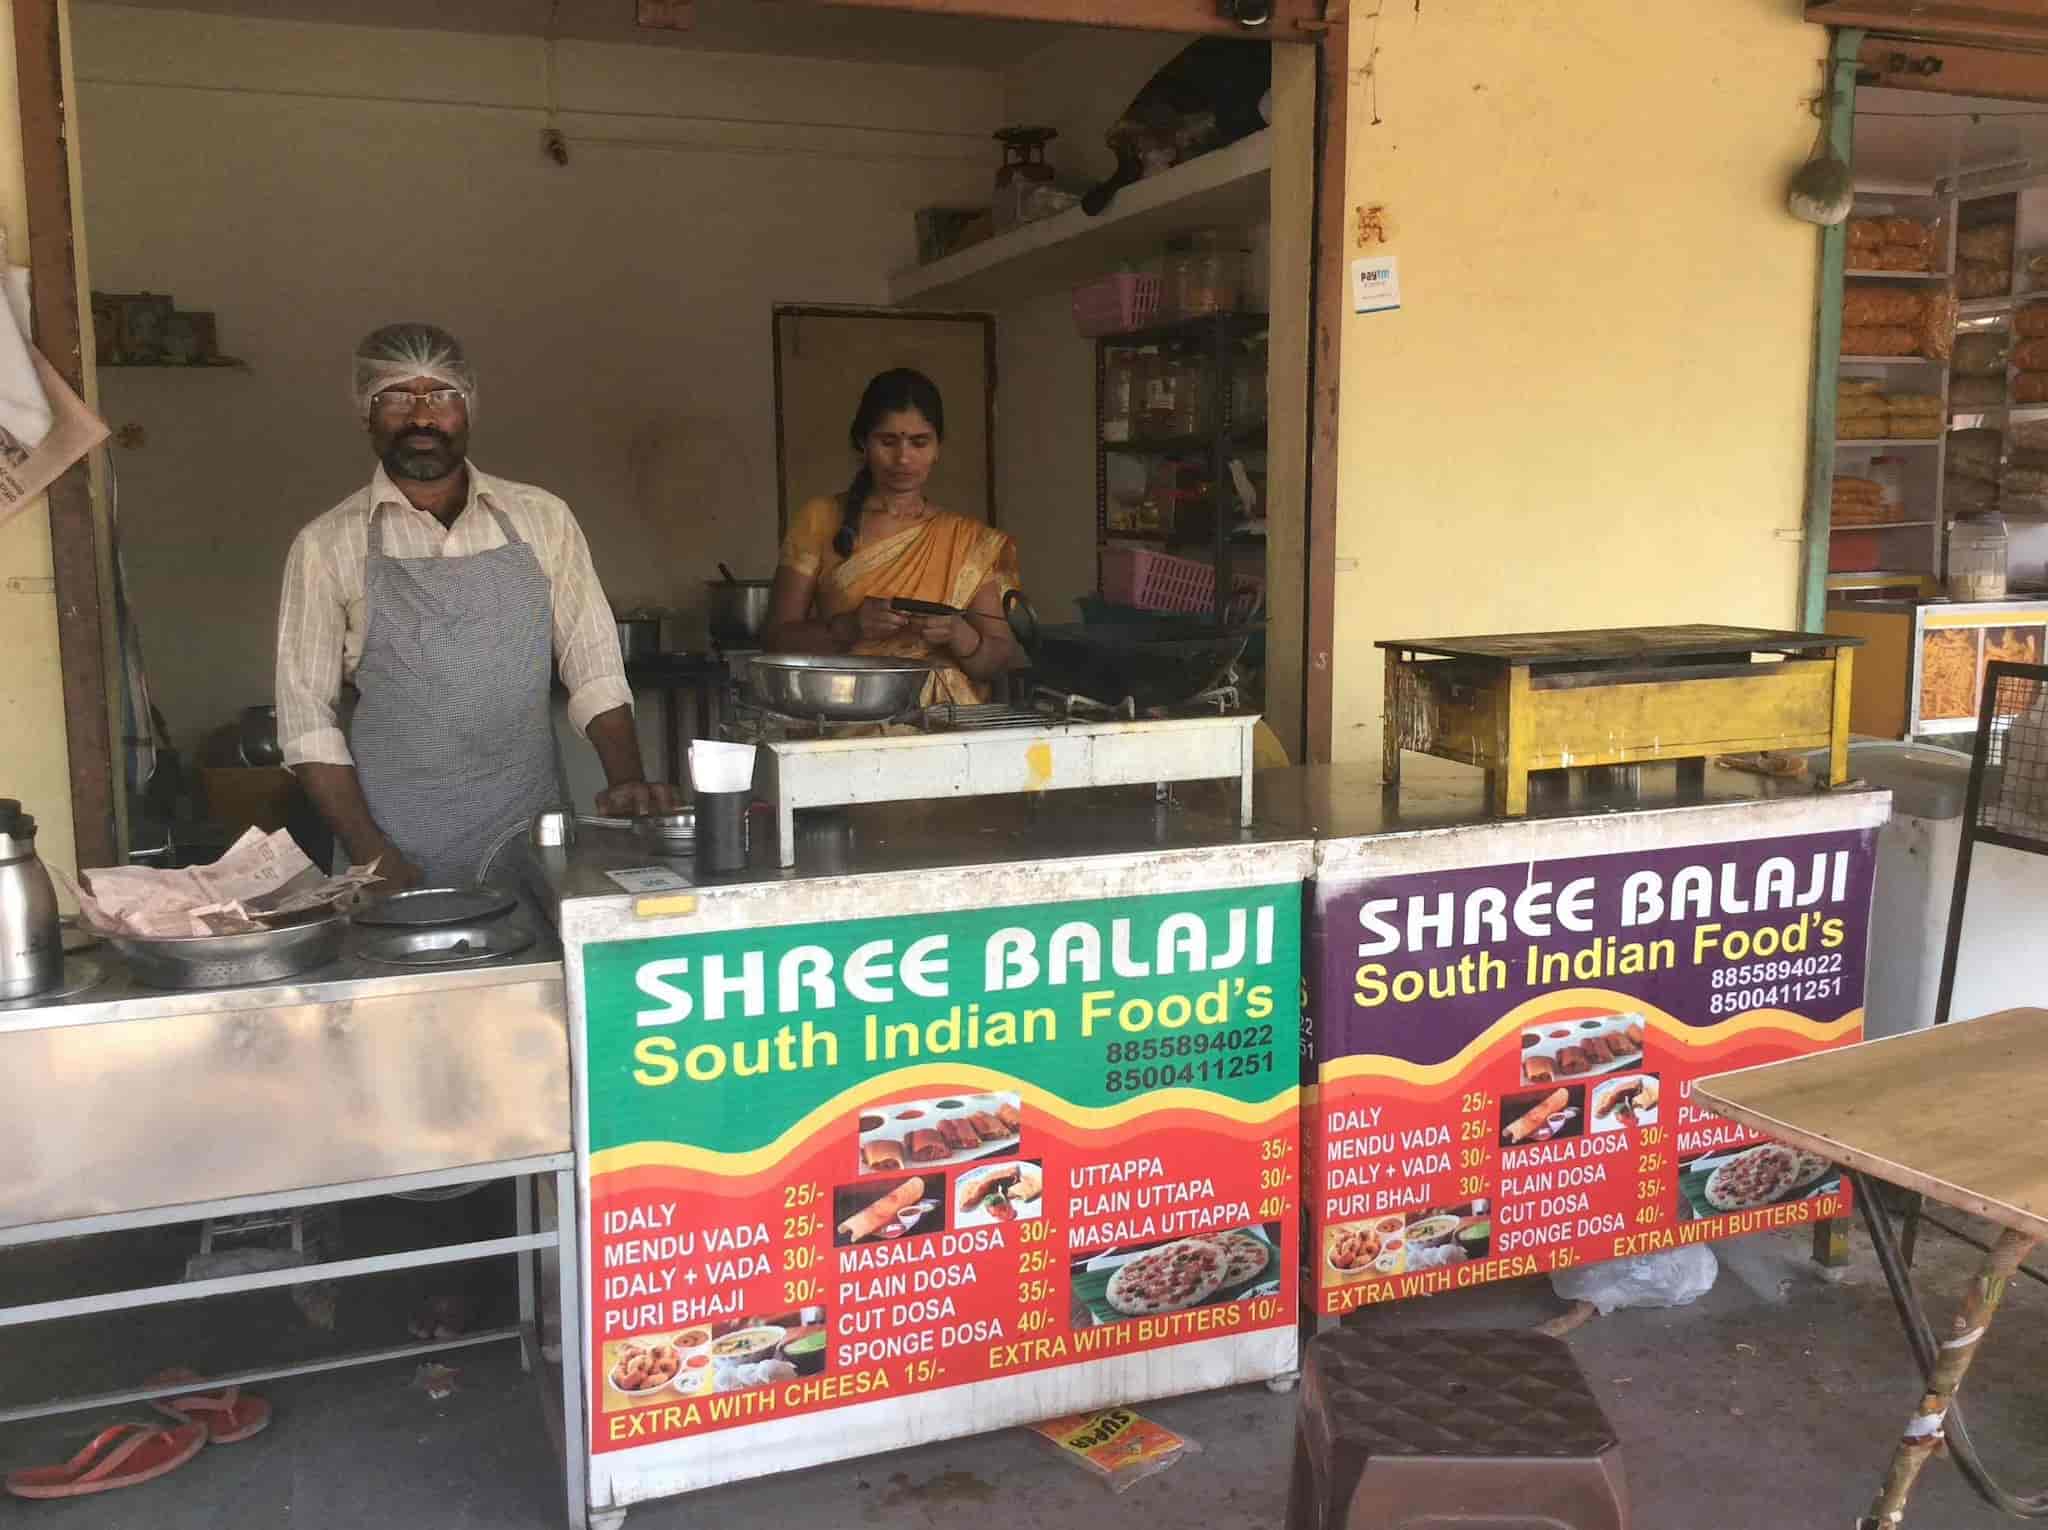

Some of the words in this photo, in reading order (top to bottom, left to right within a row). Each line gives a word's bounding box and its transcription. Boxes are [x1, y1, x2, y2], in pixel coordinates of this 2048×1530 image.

[1358, 877, 1594, 958] SHREE
[1620, 851, 1849, 928] BALAJI
[635, 934, 950, 1028] SHREE
[984, 905, 1274, 990] BALAJI
[1353, 948, 1507, 1008] South
[1527, 935, 1675, 986] Indian
[1711, 953, 1843, 990] 8855894022
[1709, 976, 1842, 1015] 8500411251
[631, 1020, 839, 1087] South
[864, 999, 1057, 1062] Indian
[1106, 1024, 1273, 1065] 8855894022
[1105, 1051, 1273, 1094] 8500411251
[1328, 1107, 1382, 1133] IDALY
[1461, 1092, 1493, 1113] 25/-
[1677, 1124, 1744, 1152] MASALA
[1070, 1157, 1164, 1189] UTTAPPA
[1261, 1138, 1293, 1161] 35/-
[1327, 1133, 1395, 1161] MENDU
[1400, 1125, 1450, 1149] VADA
[1461, 1120, 1493, 1140] 25/-
[1502, 1144, 1576, 1171] MASALA
[1581, 1134, 1629, 1157] DOSA
[1640, 1127, 1669, 1146] 30/-
[1070, 1189, 1130, 1218] PLAIN
[1137, 1178, 1215, 1209] UTTAPA
[1260, 1166, 1293, 1190] 30/-
[1327, 1163, 1380, 1190] IDALY
[1386, 1164, 1396, 1179] +
[1402, 1152, 1451, 1178] VADA
[1460, 1147, 1492, 1168] 30/-
[1501, 1172, 1551, 1198] PLAIN
[1558, 1164, 1606, 1189] DOSA
[1639, 1154, 1667, 1173] 25/-
[604, 1202, 677, 1235] IDALY
[784, 1182, 825, 1209] 25/-
[1069, 1216, 1155, 1249] MASALA
[1161, 1200, 1250, 1234] UTTAPPA
[1259, 1195, 1292, 1218] 40/-
[1326, 1193, 1370, 1219] PURI
[1375, 1183, 1430, 1211] BHAJI
[1459, 1176, 1491, 1196] 30/-
[1500, 1201, 1536, 1225] CUT
[1541, 1192, 1589, 1217] DOSA
[1638, 1179, 1666, 1199] 35/-
[604, 1234, 696, 1269] MENDU
[703, 1222, 770, 1253] VADA
[784, 1214, 825, 1240] 25/-
[839, 1241, 936, 1274] MASALA
[943, 1227, 1005, 1256] DOSA
[1020, 1219, 1057, 1244] 30/-
[1499, 1222, 1572, 1252] SPONGE
[1578, 1213, 1625, 1237] DOSA
[1636, 1205, 1664, 1224] 40/-
[1614, 1229, 1674, 1257] EXTRA
[1679, 1219, 1723, 1244] WITH
[1729, 1202, 1809, 1234] BUTTERS
[1815, 1197, 1842, 1217] 10/-
[604, 1268, 678, 1301] IDALY
[684, 1269, 698, 1285] +
[705, 1253, 772, 1285] VADA
[783, 1245, 825, 1272] 30/-
[839, 1274, 907, 1305] PLAIN
[914, 1262, 977, 1291] DOSA
[1019, 1248, 1057, 1273] 25/-
[1328, 1281, 1394, 1313] EXTRA
[1400, 1269, 1450, 1297] WITH
[1457, 1255, 1538, 1286] CHEESA
[1550, 1247, 1581, 1271] 15/-
[605, 1304, 664, 1334] PURI
[672, 1288, 745, 1325] BHAJI
[783, 1277, 825, 1304] 30/-
[839, 1307, 885, 1337] CUT
[893, 1296, 957, 1328] DOSA
[1018, 1278, 1056, 1304] 35/-
[838, 1333, 934, 1368] SPONGE
[942, 1318, 1003, 1349] DOSA
[1017, 1308, 1055, 1333] 40/-
[988, 1335, 1067, 1370] EXTRA
[1073, 1321, 1131, 1354] WITH
[1138, 1303, 1241, 1342] BUTTERS
[1248, 1297, 1285, 1322] 10/-
[609, 1403, 702, 1441] EXTRA
[709, 1388, 776, 1422] WITH
[784, 1367, 890, 1408] CHEESA
[903, 1358, 945, 1386] 15/-
